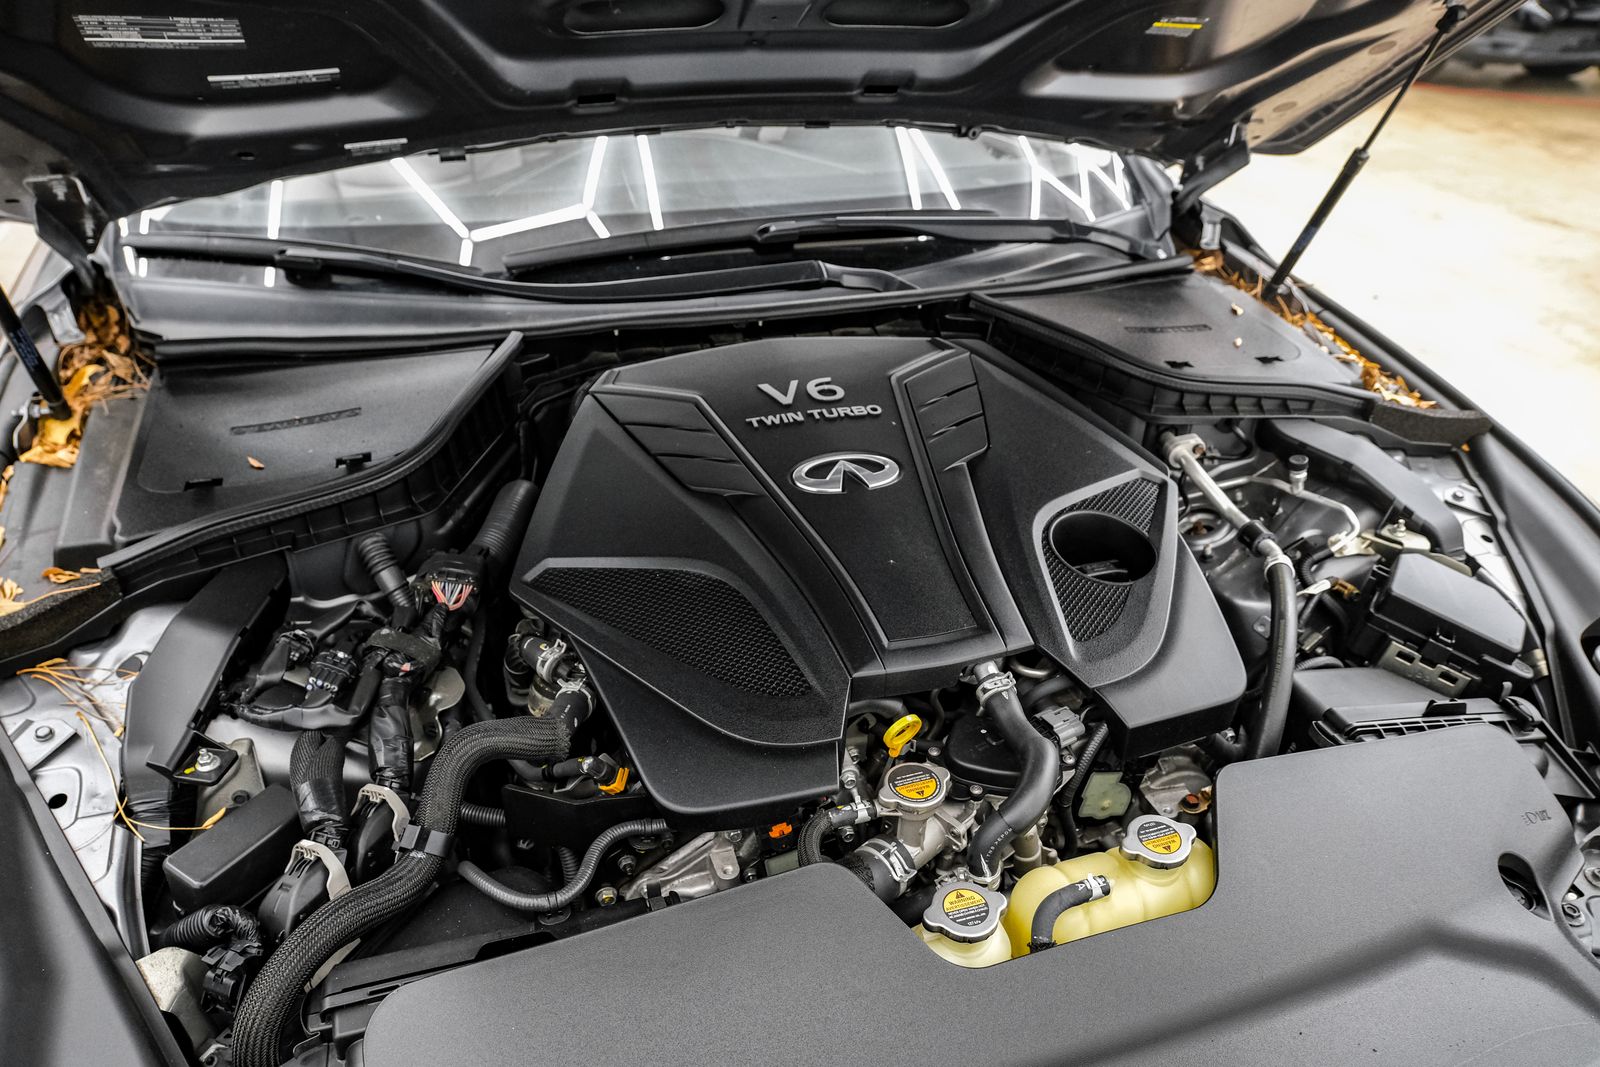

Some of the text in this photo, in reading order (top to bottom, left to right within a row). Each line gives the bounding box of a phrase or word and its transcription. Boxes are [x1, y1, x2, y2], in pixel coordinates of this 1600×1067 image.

[757, 376, 846, 405] V6
[745, 404, 882, 428] TWIN TURBO
[906, 784, 931, 794] WARNING
[1152, 839, 1176, 849] WARNING
[945, 899, 984, 911] AVERTISSEMENT
[949, 895, 976, 906] WARNING
